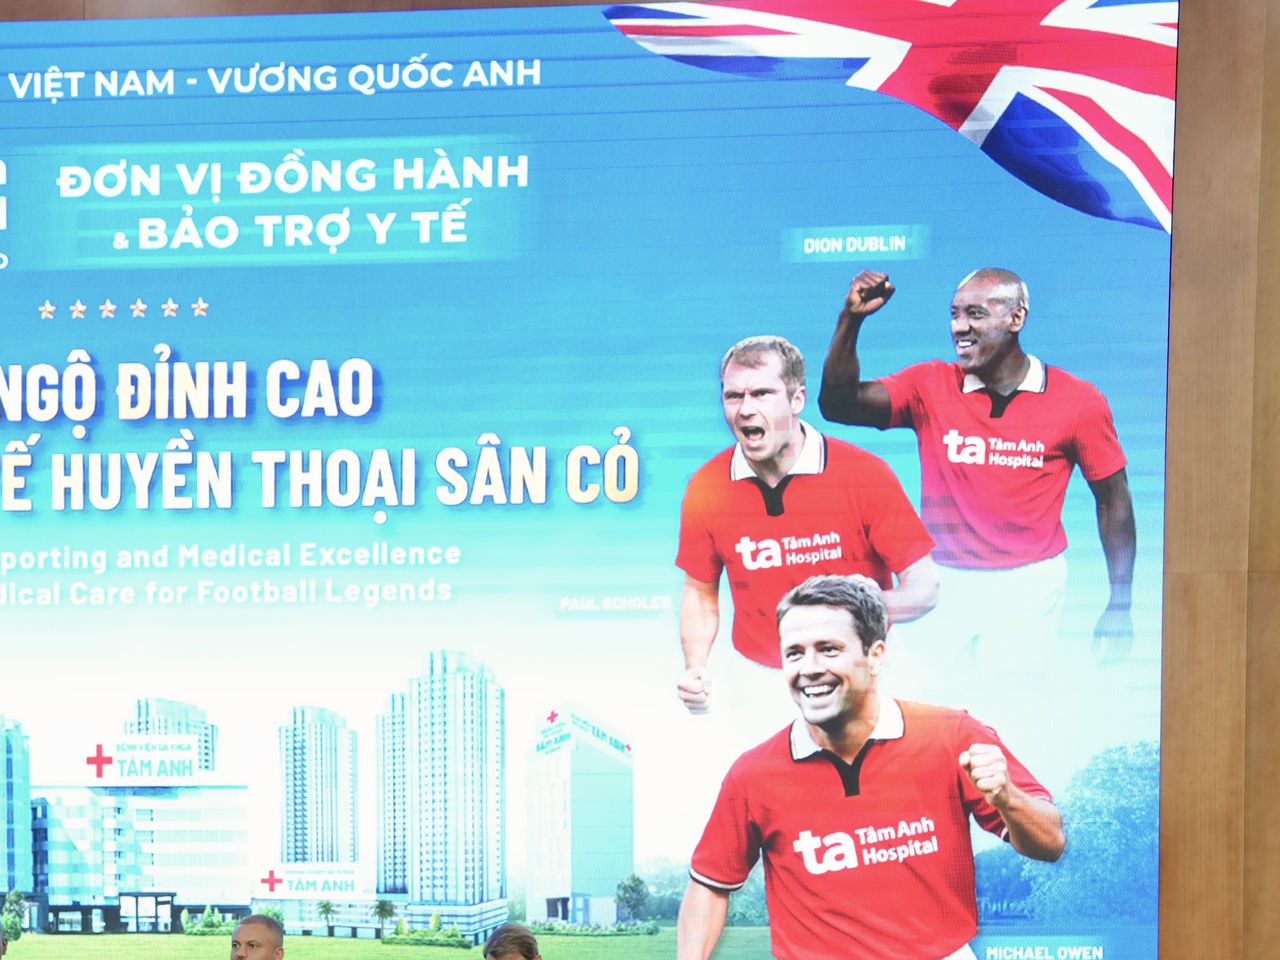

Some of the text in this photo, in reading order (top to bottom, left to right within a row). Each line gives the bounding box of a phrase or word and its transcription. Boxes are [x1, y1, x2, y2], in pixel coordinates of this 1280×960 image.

[8, 65, 85, 104] VIỆT
[95, 69, 175, 97] NAM
[208, 62, 337, 94] VƯƠNG
[348, 53, 454, 95] QUỐC
[462, 59, 541, 87] ANH
[56, 148, 529, 204] ĐƠN VỊ ĐỒNG HÀNH
[113, 198, 472, 254] & BẢO TRỢ Y TẾ
[804, 236, 906, 254] DION DUBLIN
[116, 343, 248, 420] ĐỈNH
[265, 358, 375, 419] CAO
[943, 429, 986, 464] ta
[988, 438, 1045, 453] Tâm Anh
[988, 452, 1044, 469] Hospital
[51, 428, 233, 511] HUYỀN
[251, 447, 417, 525] THOẠI
[435, 432, 548, 507] SÂN
[565, 425, 641, 505] CỎ
[735, 535, 782, 571] ta
[781, 531, 840, 550] Tâm Anh
[116, 543, 169, 569] and
[178, 543, 291, 569] Medical
[300, 541, 462, 567] Excellence
[786, 546, 842, 566] Hospital
[69, 581, 136, 606] Care
[145, 579, 188, 605] for
[197, 577, 316, 604] Football
[325, 576, 453, 609] Legends
[560, 596, 672, 611] PAUL SCHOLES
[157, 759, 193, 777] ANH
[855, 817, 935, 845] Tâm Anh
[793, 830, 858, 875] ta
[862, 835, 939, 866] Hospital
[321, 880, 354, 892] ANH
[1057, 945, 1103, 960] OWEN
